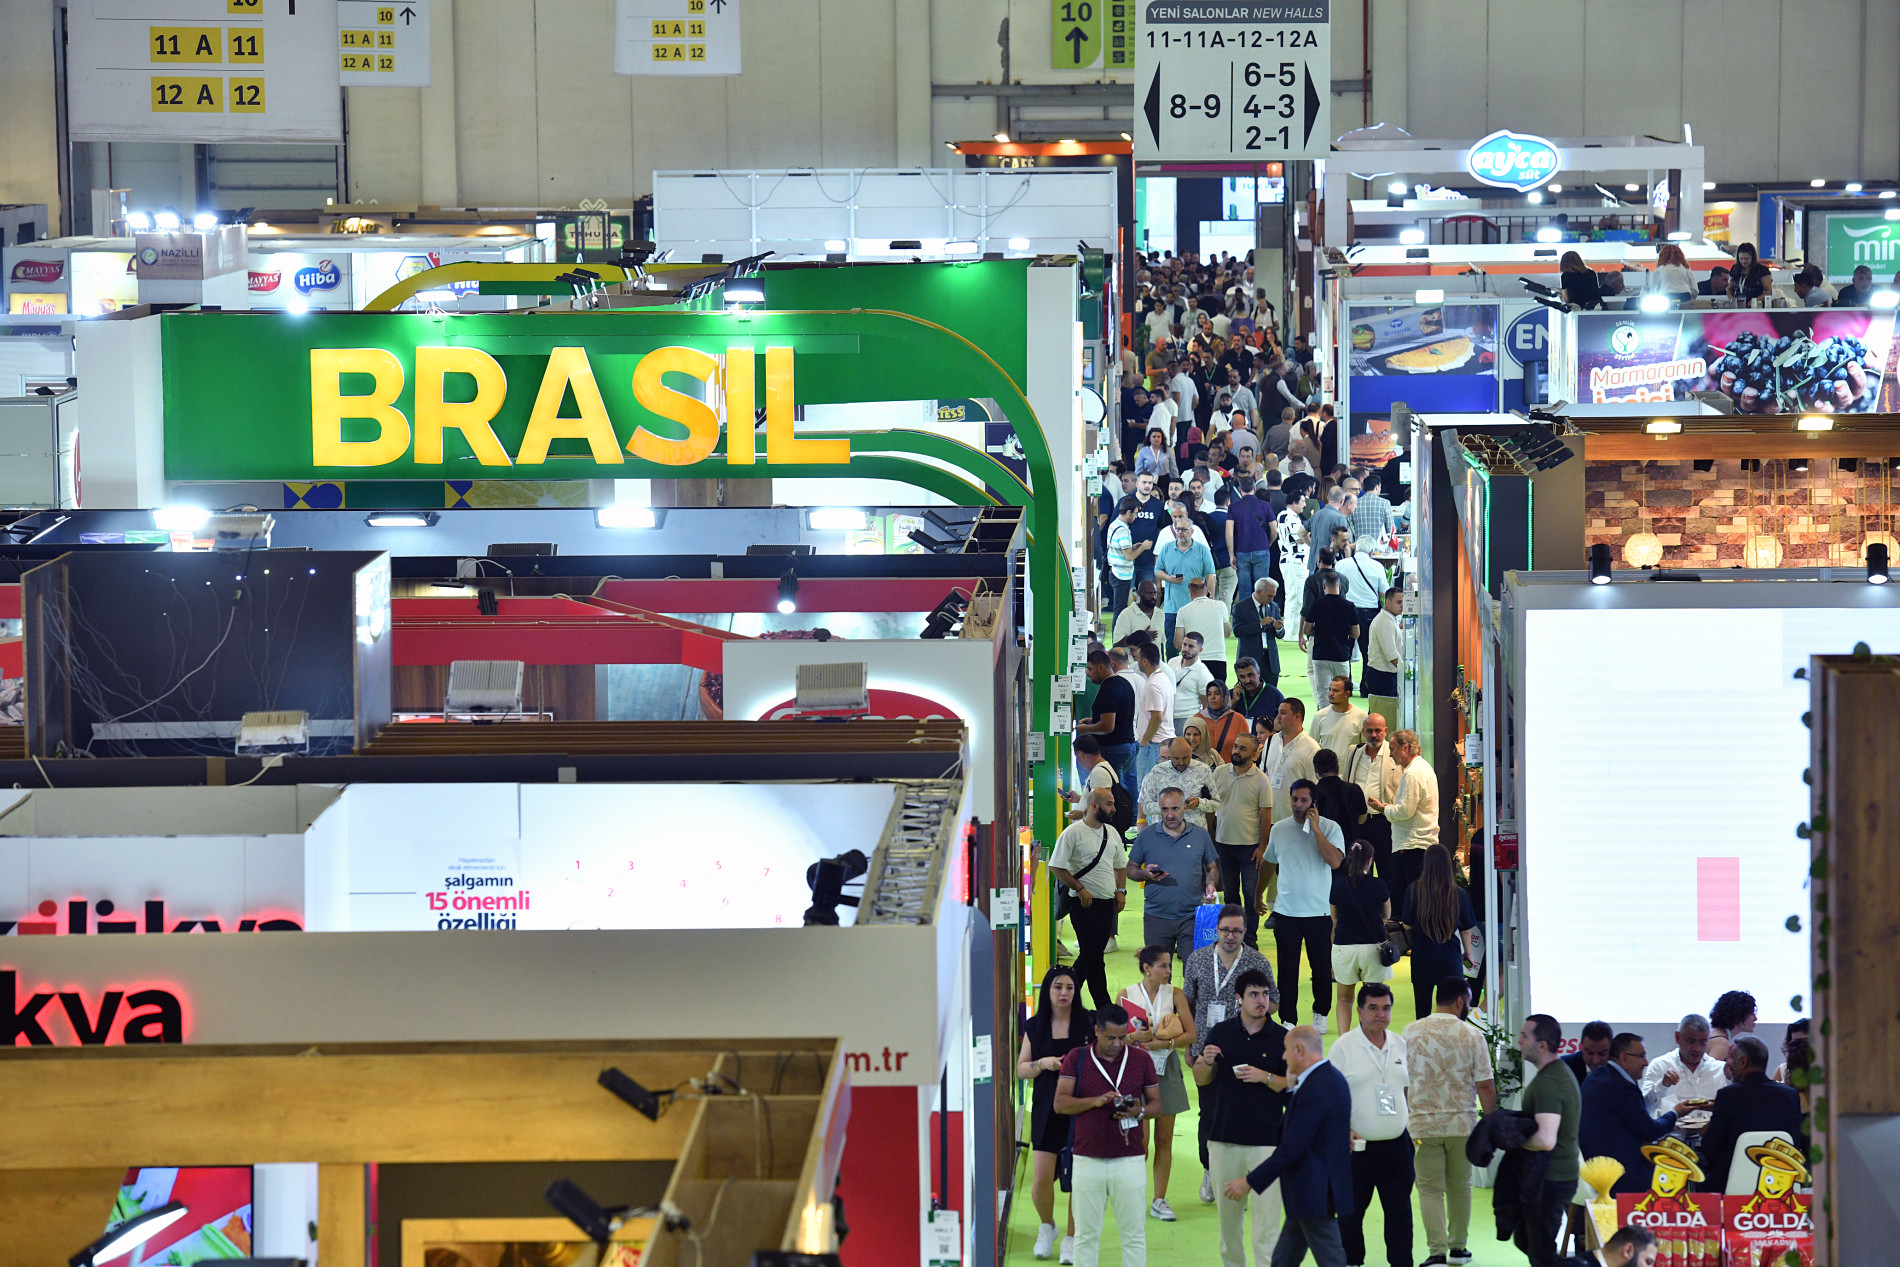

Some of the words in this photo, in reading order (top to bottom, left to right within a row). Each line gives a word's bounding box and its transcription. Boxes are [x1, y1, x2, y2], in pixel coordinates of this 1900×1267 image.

[691, 1, 703, 11] 10
[1061, 2, 1092, 22] 10
[1151, 5, 1180, 18] YENİ
[1183, 7, 1249, 19] SALONLAR
[1252, 7, 1282, 18] NEW
[1285, 7, 1323, 18] HALLS
[379, 11, 392, 21] 10
[654, 24, 667, 34] 11
[673, 24, 682, 34] A
[691, 24, 703, 34] 11
[155, 35, 181, 55] 11
[195, 35, 213, 56] A
[233, 36, 259, 56] 11
[343, 34, 356, 44] 11
[362, 34, 371, 45] A
[380, 35, 392, 45] 11
[1147, 30, 1318, 48] 11-11A-12-12A
[655, 47, 667, 58] 12
[673, 47, 682, 58] A
[691, 47, 703, 58] 12
[343, 57, 356, 68] 12
[362, 58, 371, 69] A
[380, 58, 392, 69] 12
[1244, 62, 1296, 87] 6-5
[156, 85, 183, 105] 12
[197, 84, 214, 105] A
[234, 85, 260, 105] 12
[1170, 94, 1221, 119] 8-9
[1243, 94, 1295, 119] 4-3
[1245, 125, 1290, 150] 2-1
[1518, 168, 1541, 180] süt
[161, 248, 199, 258] NAZİLLİ
[25, 265, 60, 275] MAYYAS
[299, 269, 335, 287] Hiba
[1593, 361, 1703, 388] Marmaranın
[310, 346, 851, 468] BRASIL
[575, 860, 581, 870] 1
[628, 860, 635, 871] 3
[715, 860, 722, 870] 5
[763, 867, 770, 877] 7
[444, 873, 513, 891] şalgamın
[679, 879, 686, 888] 4
[607, 887, 614, 897] 2
[425, 891, 448, 911] 15
[452, 890, 530, 911] önemli
[437, 912, 517, 931] özelliği
[775, 914, 782, 924] 8
[1627, 1211, 1707, 1227] GOLDA
[1733, 1212, 1815, 1231] GOLDA
